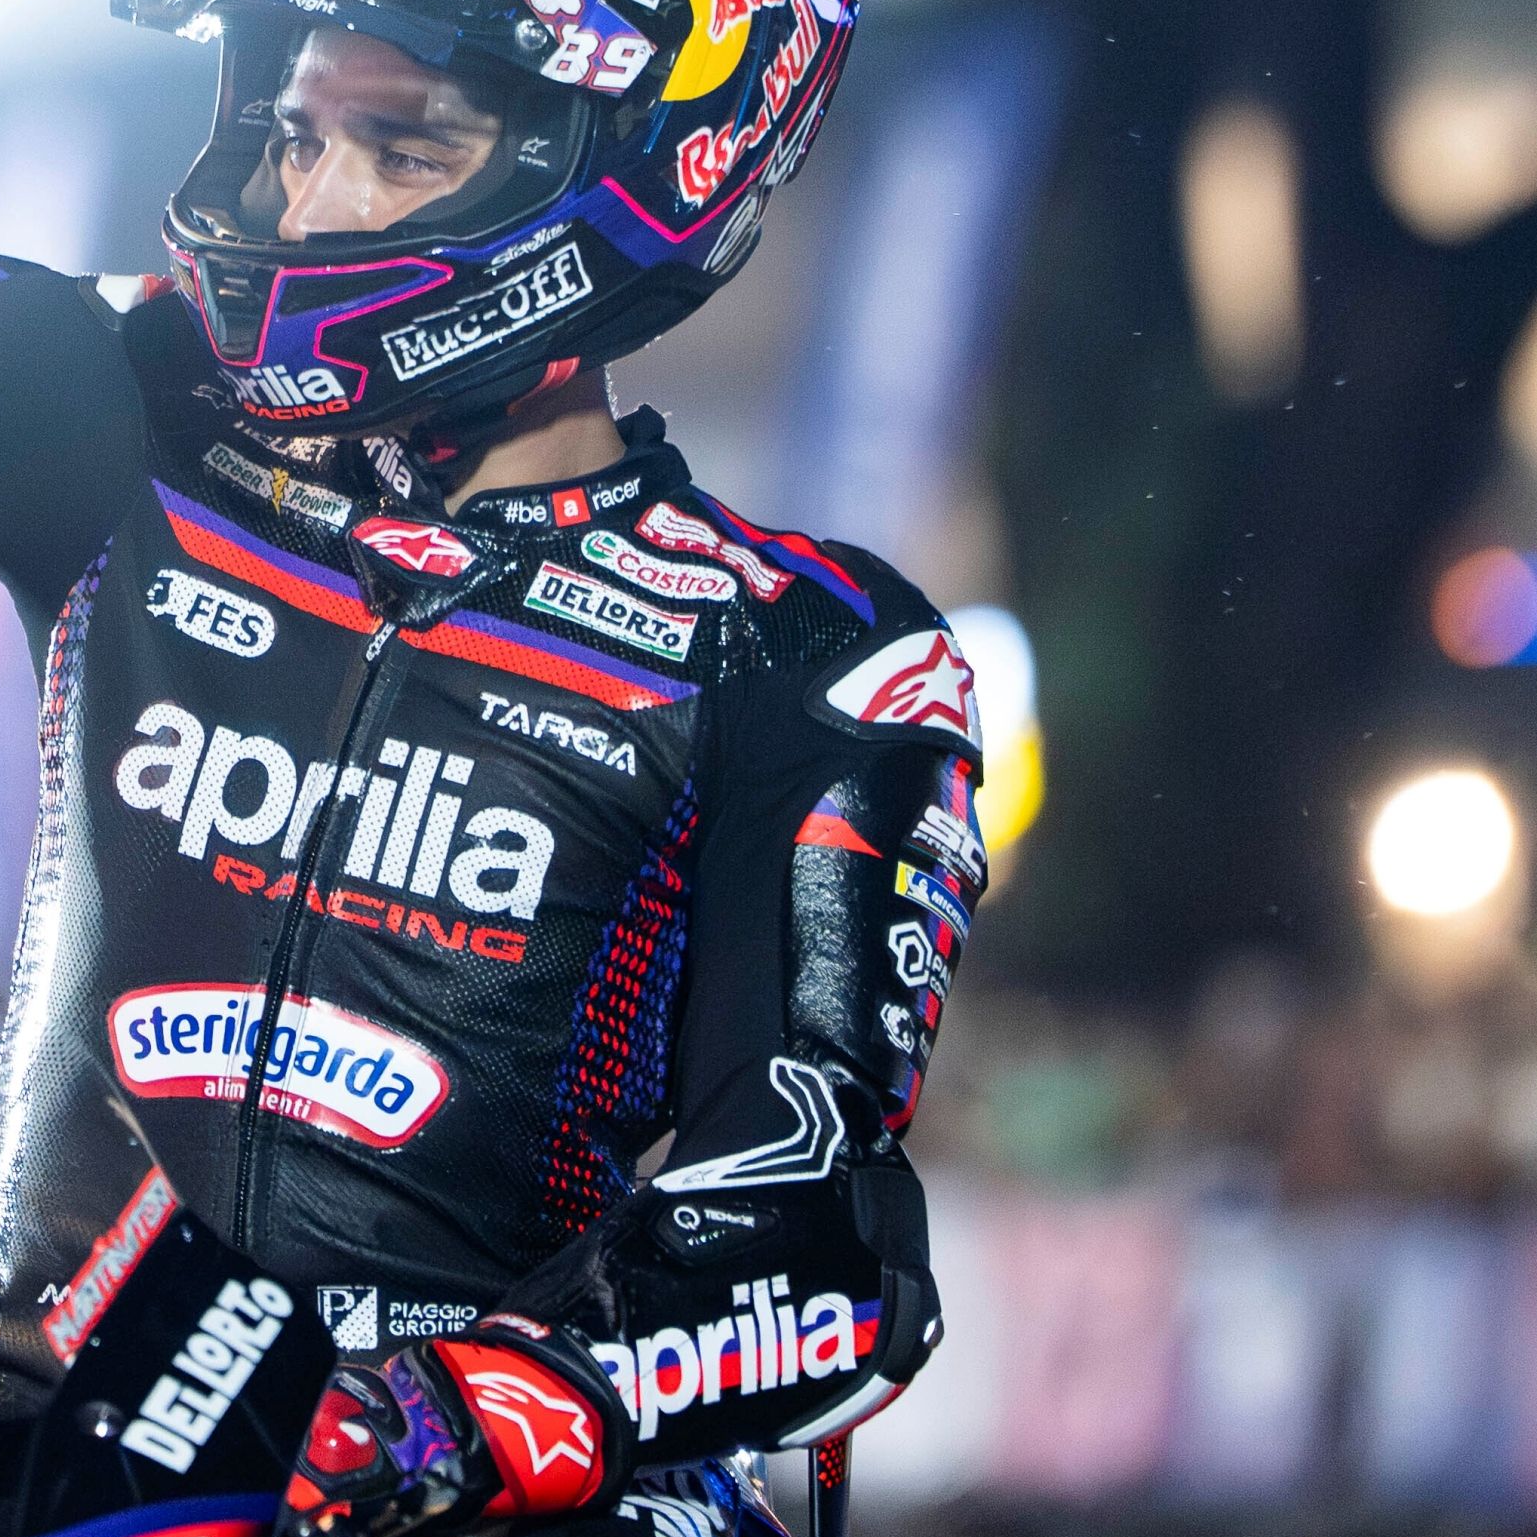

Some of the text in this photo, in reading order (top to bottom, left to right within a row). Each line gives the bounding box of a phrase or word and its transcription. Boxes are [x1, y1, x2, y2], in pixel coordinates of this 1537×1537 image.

[539, 24, 652, 90] 89
[395, 252, 578, 370] Muc-Off
[243, 398, 351, 420] RACING
[289, 485, 342, 517] Power
[504, 477, 642, 524] #be a racer
[617, 552, 730, 595] Castrol
[540, 576, 681, 649] DELLORTO
[479, 692, 637, 777] TARGA
[115, 702, 555, 921] aprilia
[915, 805, 987, 880] SC
[213, 854, 527, 964] RACING
[128, 999, 414, 1115] sterilgarda
[388, 1319, 466, 1337] GROUP
[389, 1302, 478, 1321] PIAGGIO
[120, 1276, 295, 1475] DELLORTO
[589, 1273, 858, 1442] aprilia
